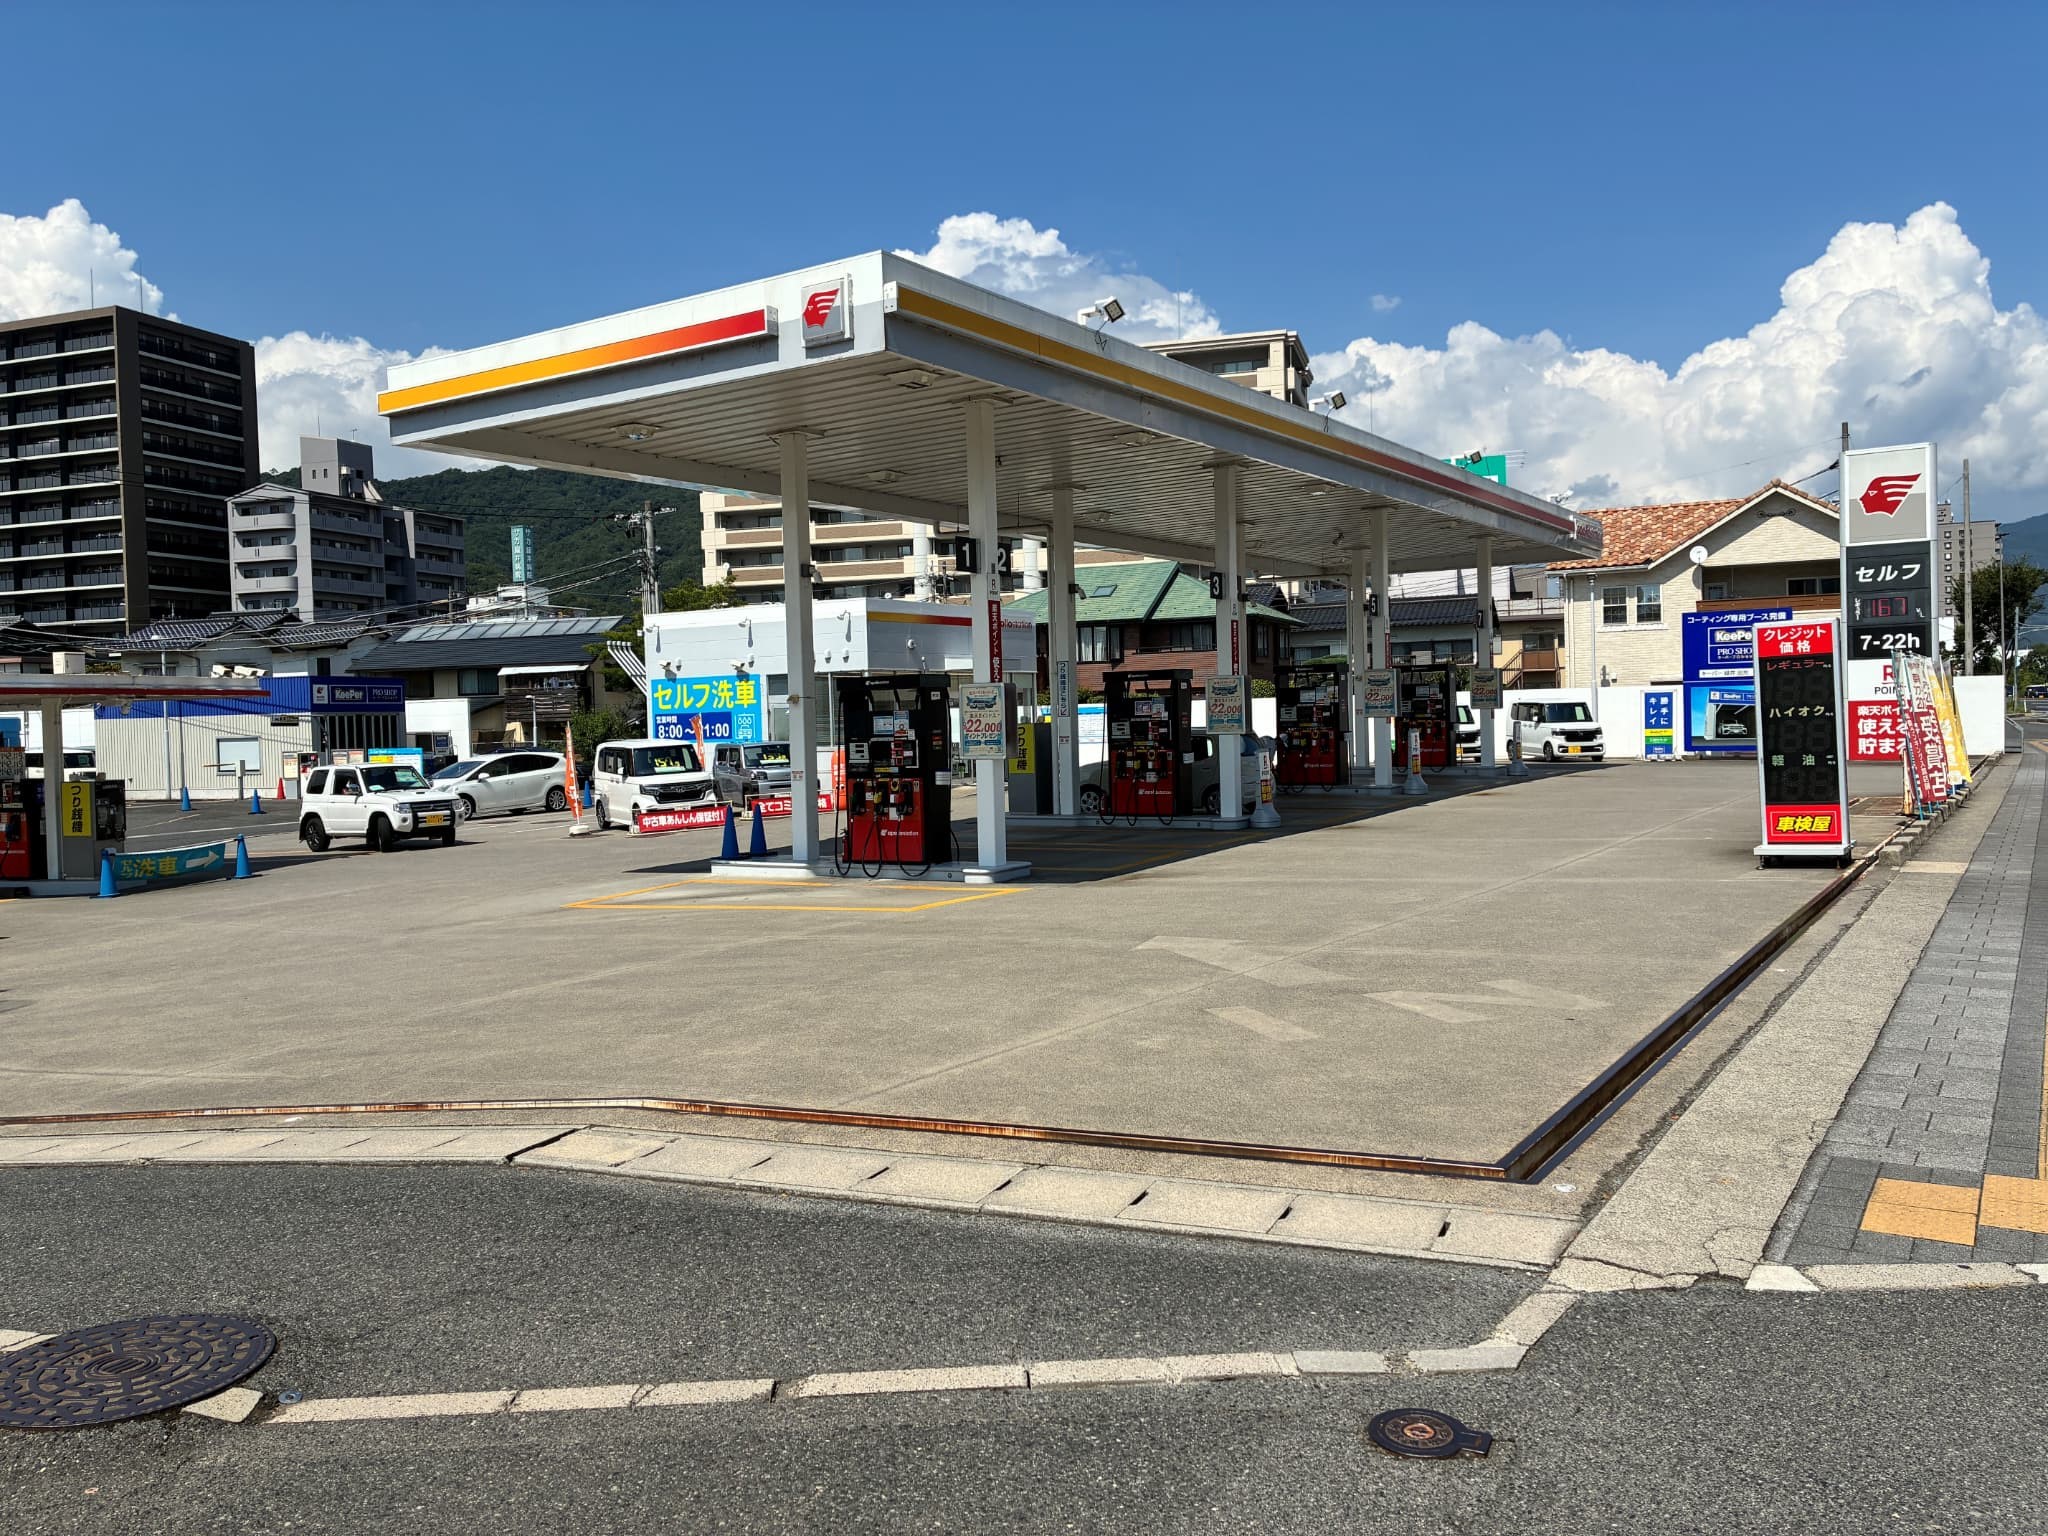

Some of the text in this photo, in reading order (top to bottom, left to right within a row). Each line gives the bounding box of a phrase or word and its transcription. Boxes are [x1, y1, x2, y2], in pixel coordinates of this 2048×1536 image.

[962, 543, 970, 567] 1
[998, 547, 1006, 571] 2
[1855, 564, 1920, 582] セルフ
[1213, 576, 1220, 595] 3
[1371, 597, 1376, 613] 5
[1872, 597, 1907, 617] 167
[1688, 612, 1786, 623] コーティング専用ブース完備
[1716, 630, 1752, 642] KeePe
[1763, 625, 1827, 641] クレジット
[1780, 640, 1810, 654] 価格
[1860, 633, 1920, 650] 7-22h
[1718, 648, 1734, 656] PRO
[1766, 660, 1824, 670] レギュラー
[1883, 665, 1895, 681] R
[654, 680, 757, 709] セルフ洗車
[1874, 686, 1898, 694] POIN
[1649, 697, 1657, 725] キレイ
[1769, 705, 1825, 718] ハイオク
[1857, 705, 1900, 716] 楽天ポイ
[1771, 754, 1815, 766] 軽油
[72, 785, 84, 832] つり銭機
[1776, 816, 1832, 832] 車検屋
[133, 857, 178, 878] 洗車
